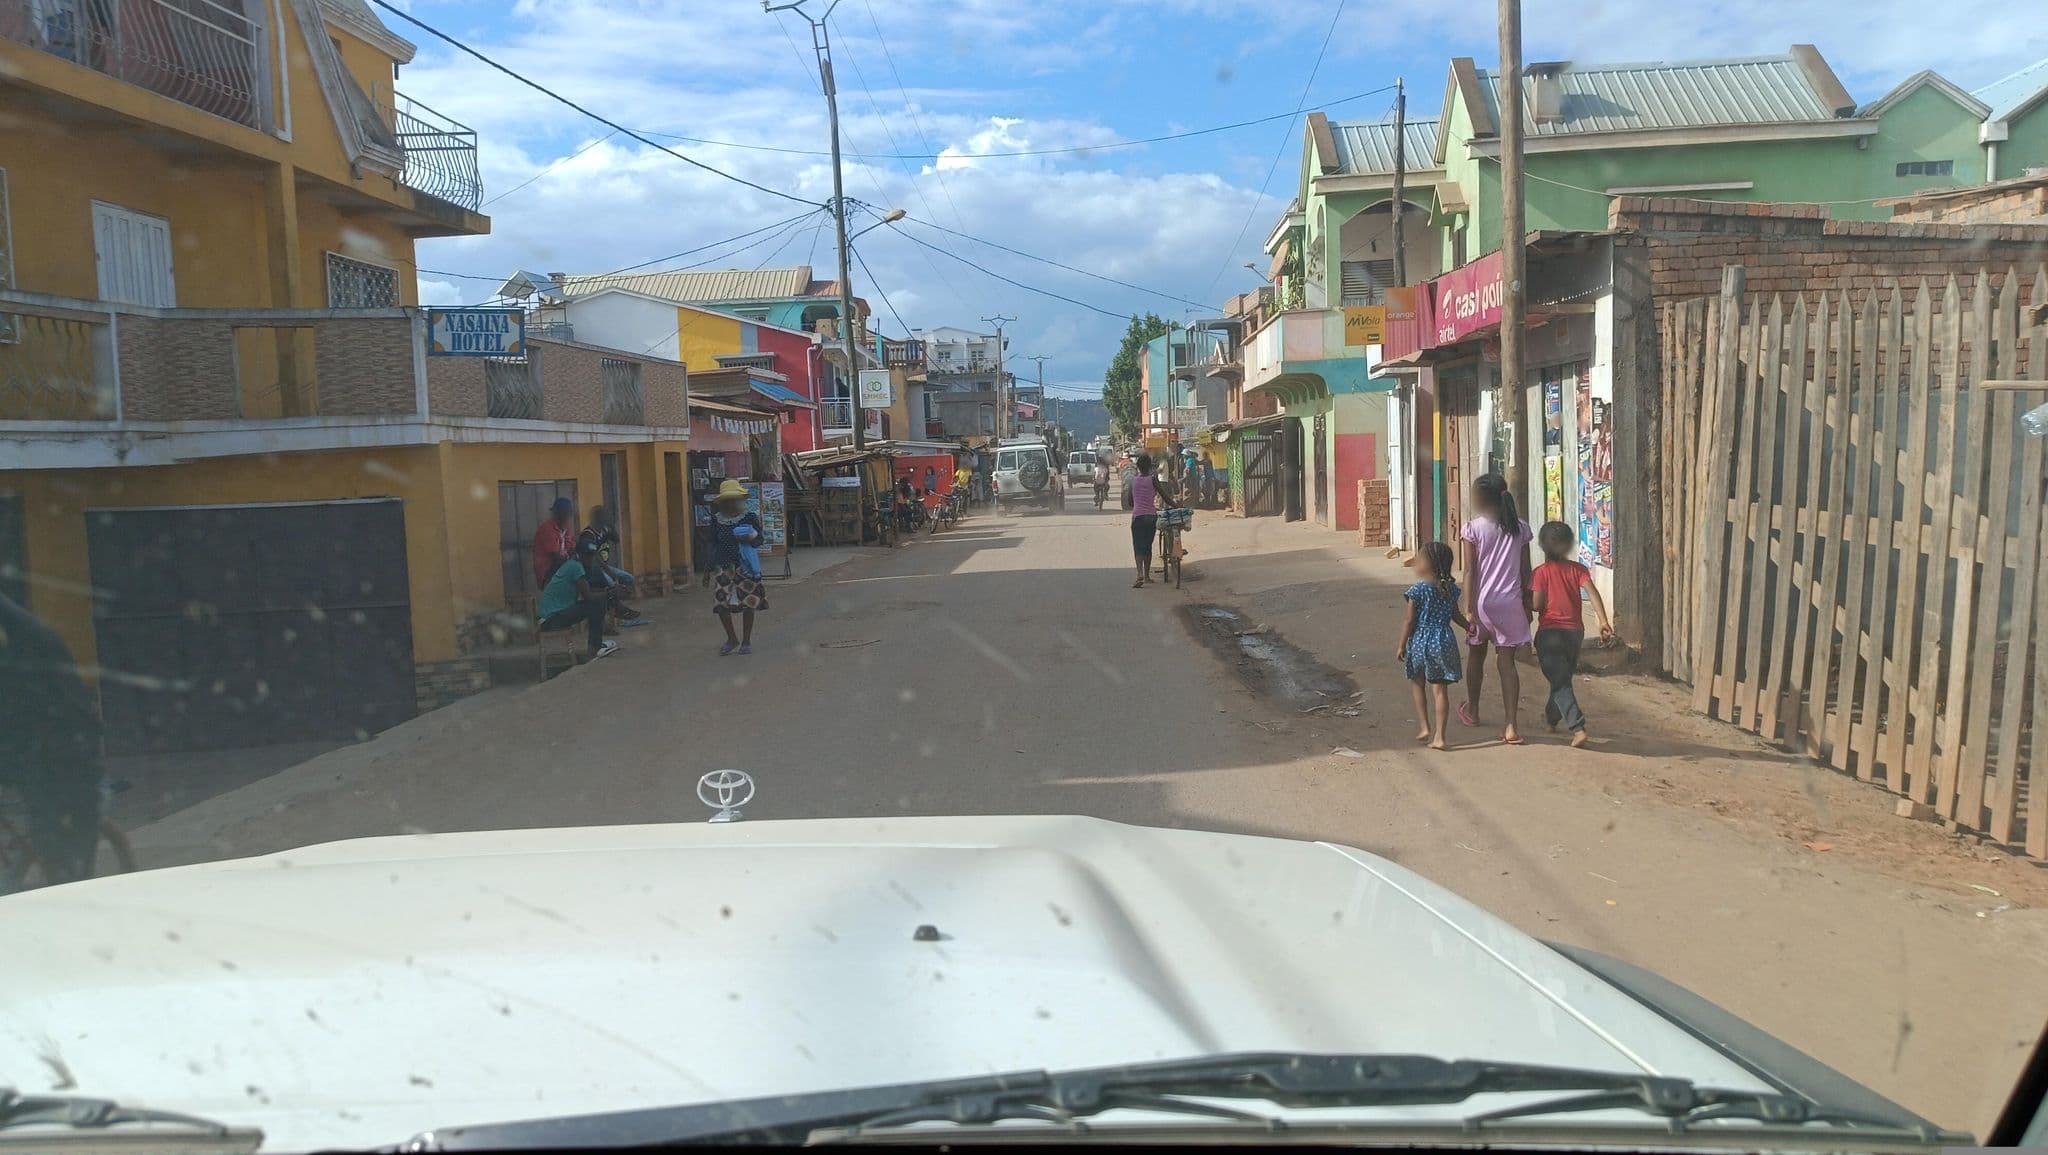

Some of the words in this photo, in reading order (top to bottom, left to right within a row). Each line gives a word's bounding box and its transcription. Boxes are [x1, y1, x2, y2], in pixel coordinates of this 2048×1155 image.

[445, 313, 509, 333] NASAINA
[1387, 311, 1416, 320] orange
[451, 332, 506, 352] HOTEL
[1439, 324, 1456, 343] airtel
